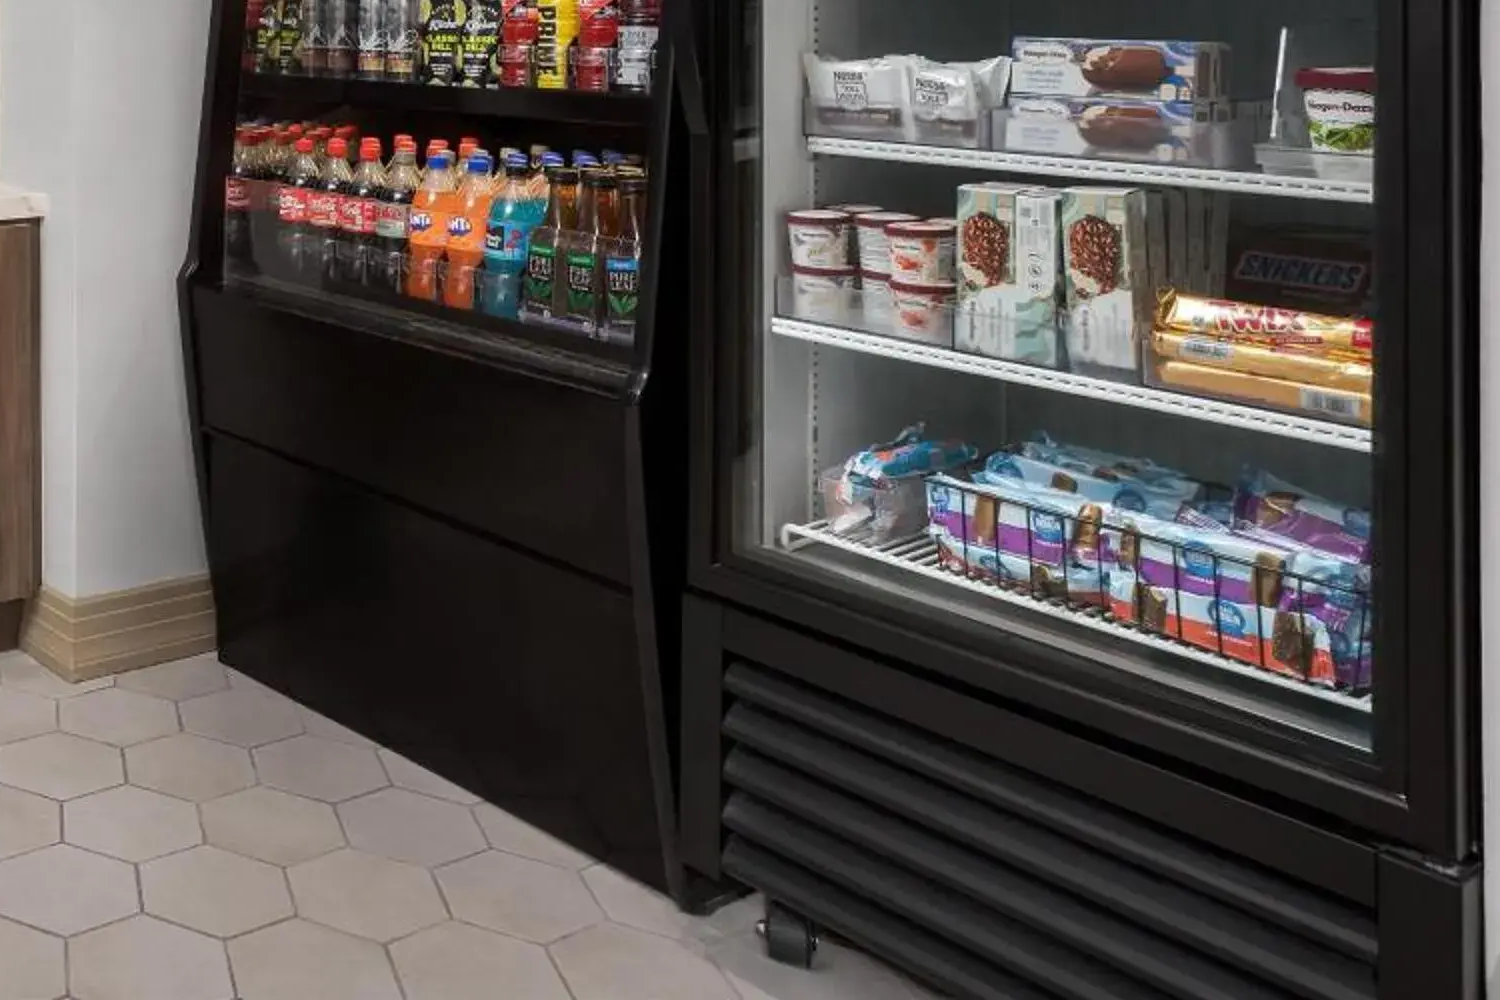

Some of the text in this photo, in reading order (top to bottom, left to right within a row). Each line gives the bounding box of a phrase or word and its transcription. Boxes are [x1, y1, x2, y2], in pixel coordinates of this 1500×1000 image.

[609, 271, 636, 282] PURE
[1239, 253, 1361, 289] SNICKERS
[611, 281, 634, 291] LEAF
